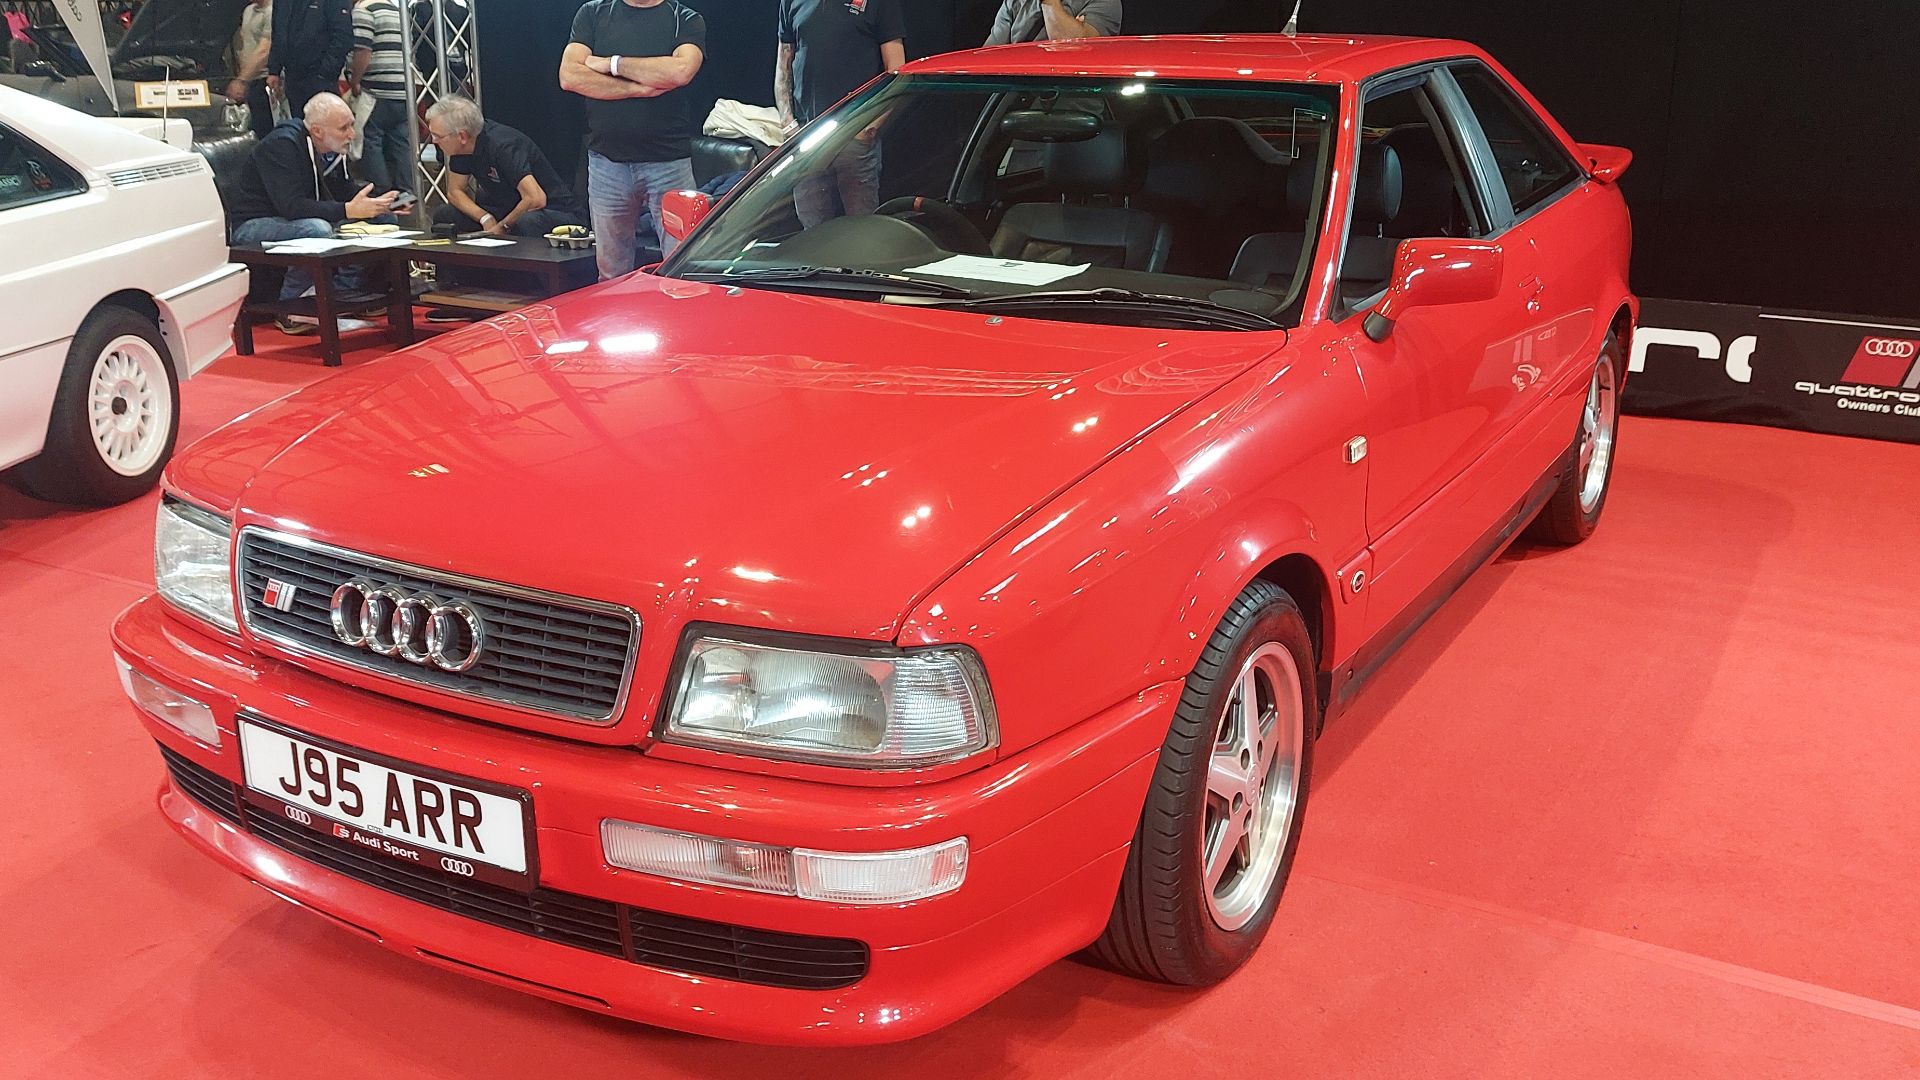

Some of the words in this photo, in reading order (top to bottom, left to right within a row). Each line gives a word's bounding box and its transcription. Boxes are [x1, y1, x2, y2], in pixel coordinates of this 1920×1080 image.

[1795, 381, 1920, 402] quattro
[1837, 398, 1890, 413] Owners
[279, 741, 364, 818] J95
[383, 772, 485, 854] ARR
[353, 831, 381, 849] Audi
[383, 841, 420, 861] Sport
